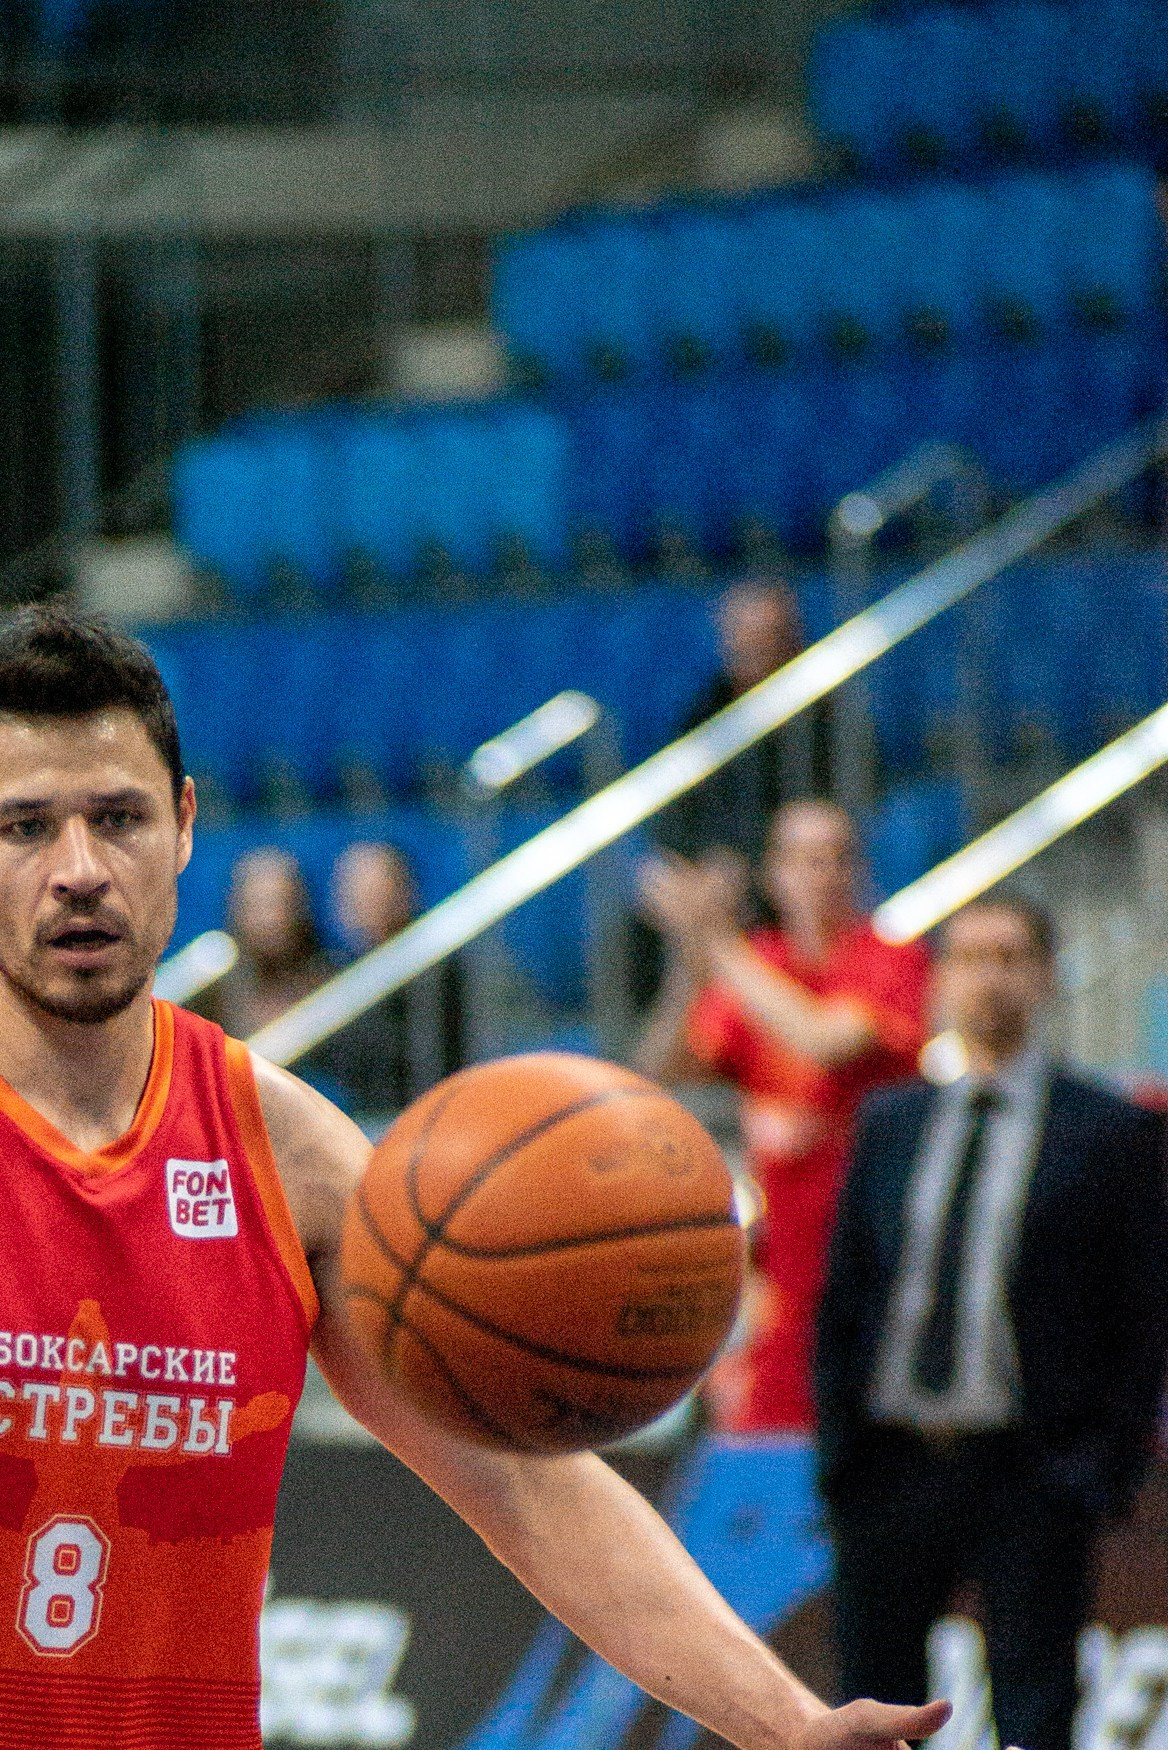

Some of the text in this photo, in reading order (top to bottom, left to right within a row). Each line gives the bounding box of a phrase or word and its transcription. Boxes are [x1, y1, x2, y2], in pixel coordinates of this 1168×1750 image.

[172, 1169, 227, 1196] FON
[176, 1198, 232, 1226] BET
[16, 1514, 111, 1658] 8
